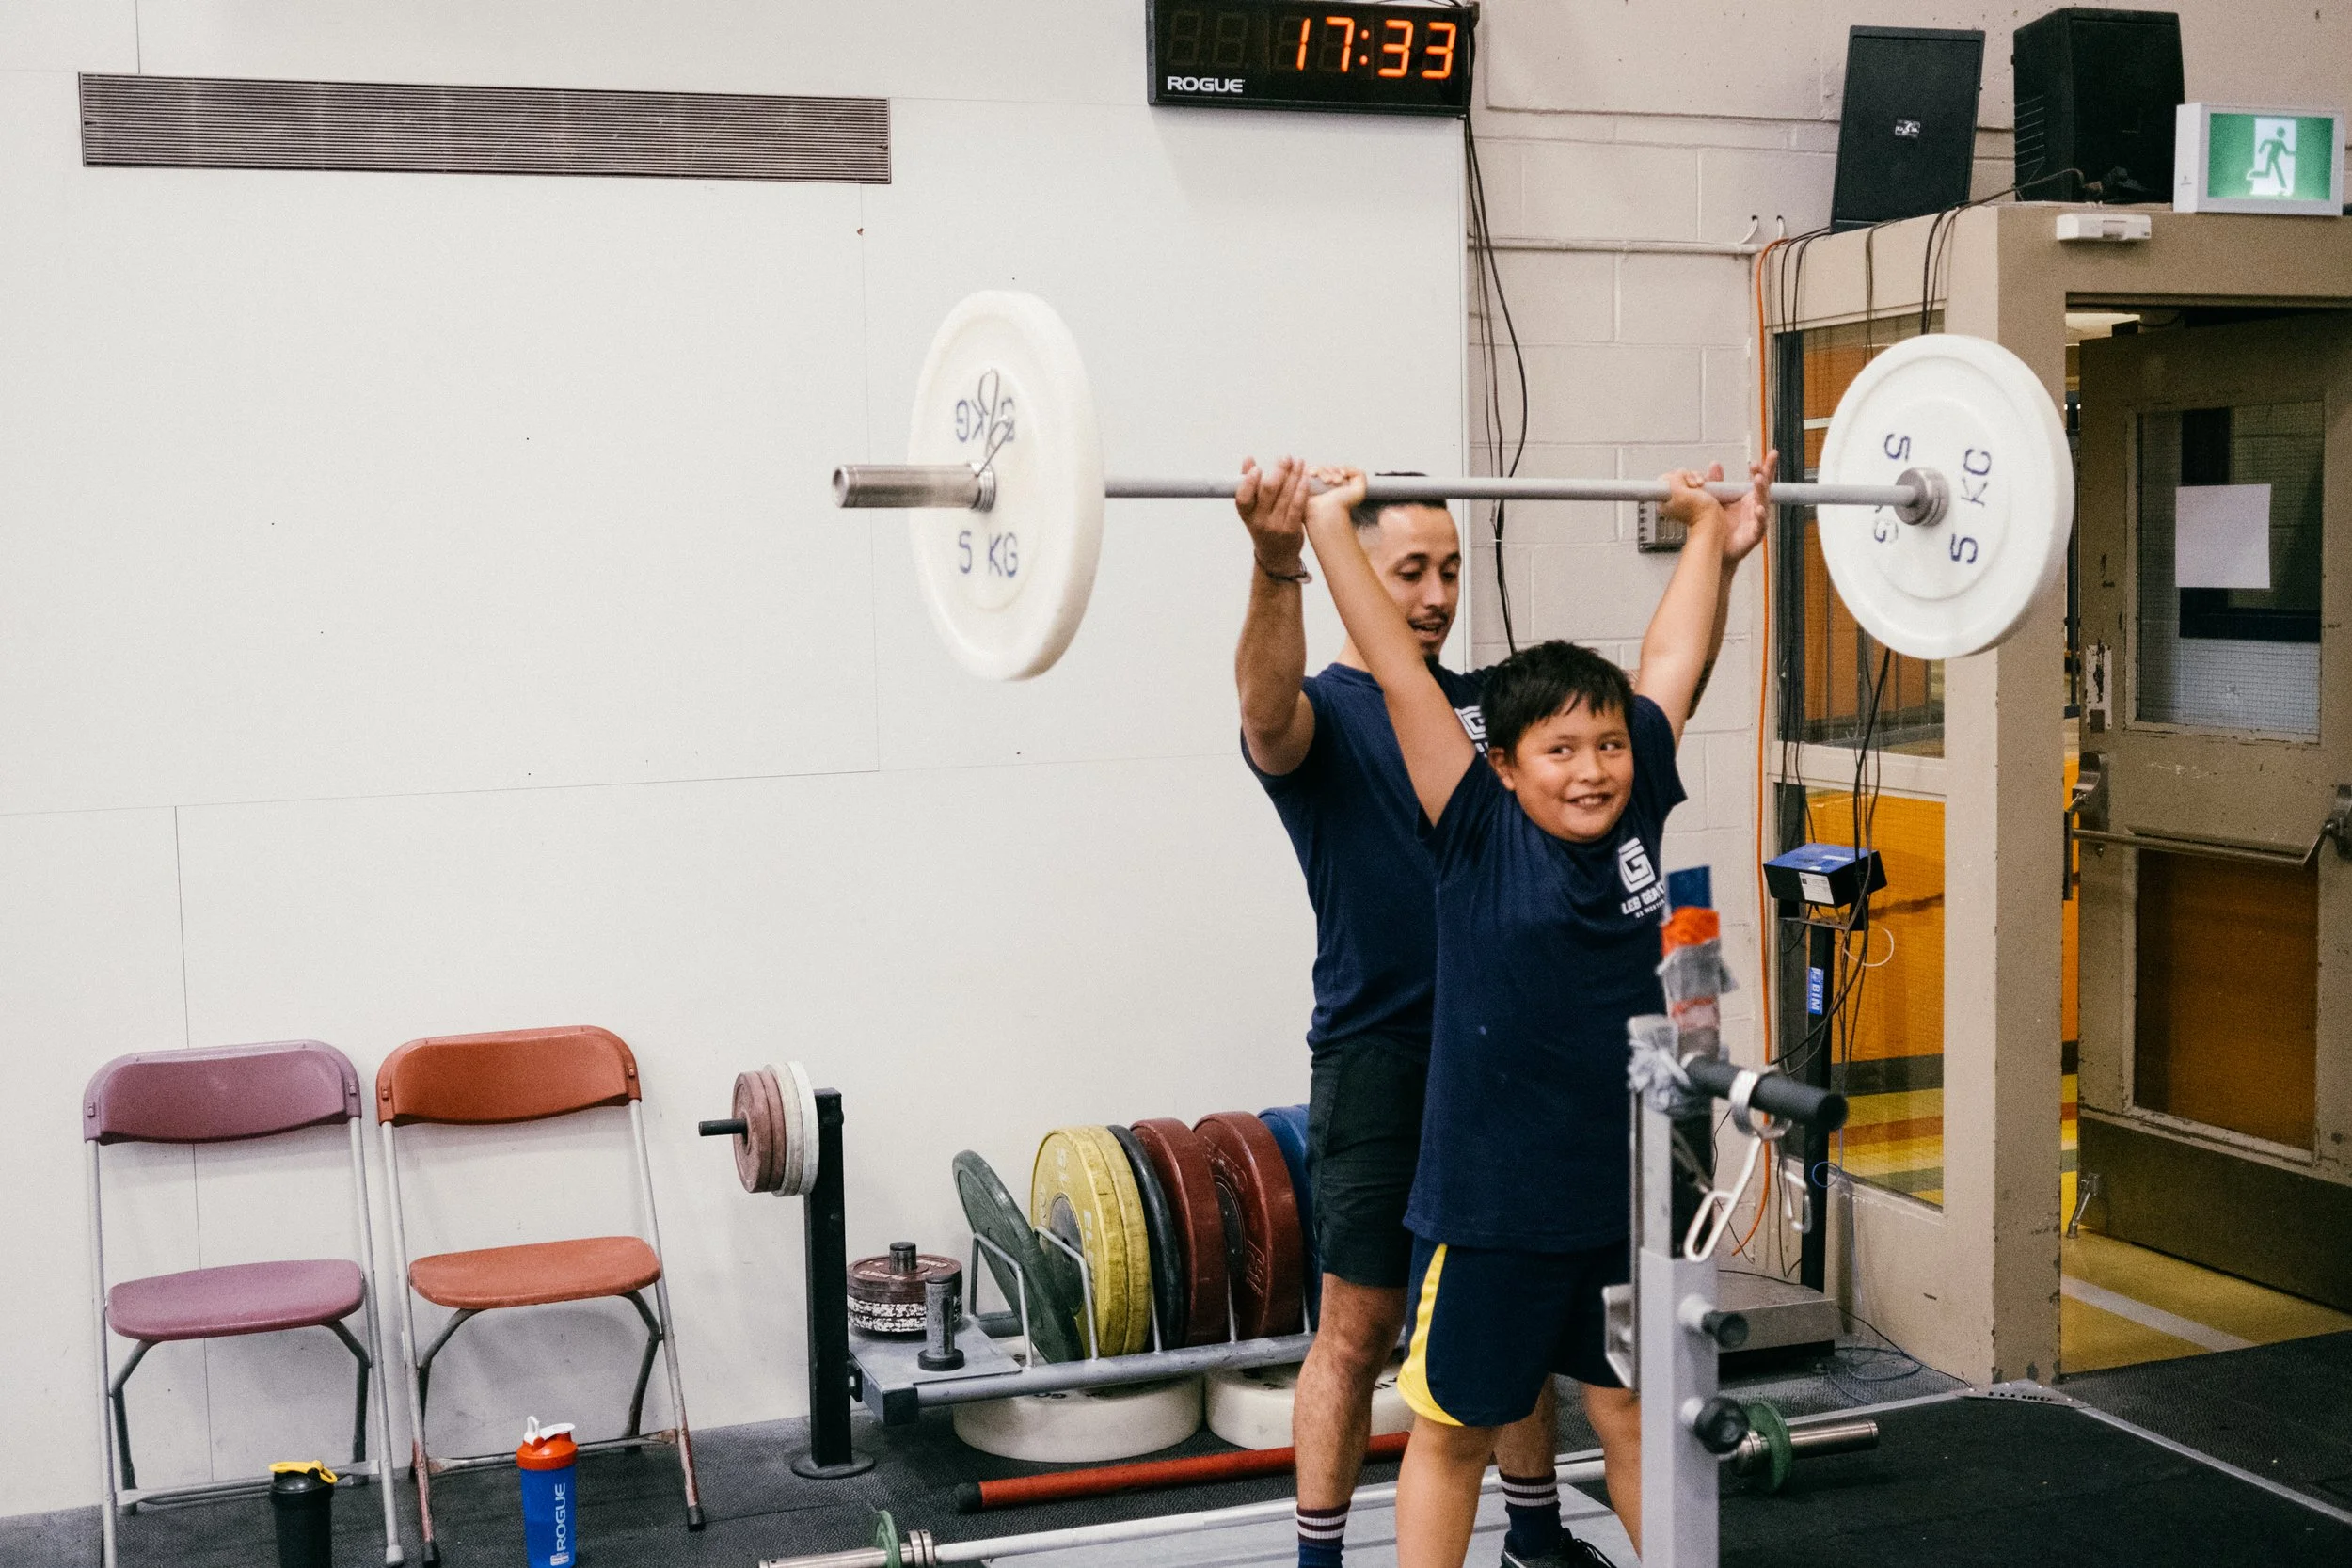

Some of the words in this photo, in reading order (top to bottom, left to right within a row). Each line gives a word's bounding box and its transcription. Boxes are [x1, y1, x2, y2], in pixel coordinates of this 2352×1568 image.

[1296, 16, 1456, 79] 17:33
[1168, 76, 1244, 93] ROGUE
[958, 530, 973, 574] 5
[988, 531, 1019, 578] KG
[1949, 533, 1979, 564] 5
[555, 1482, 567, 1552] ROGUE
